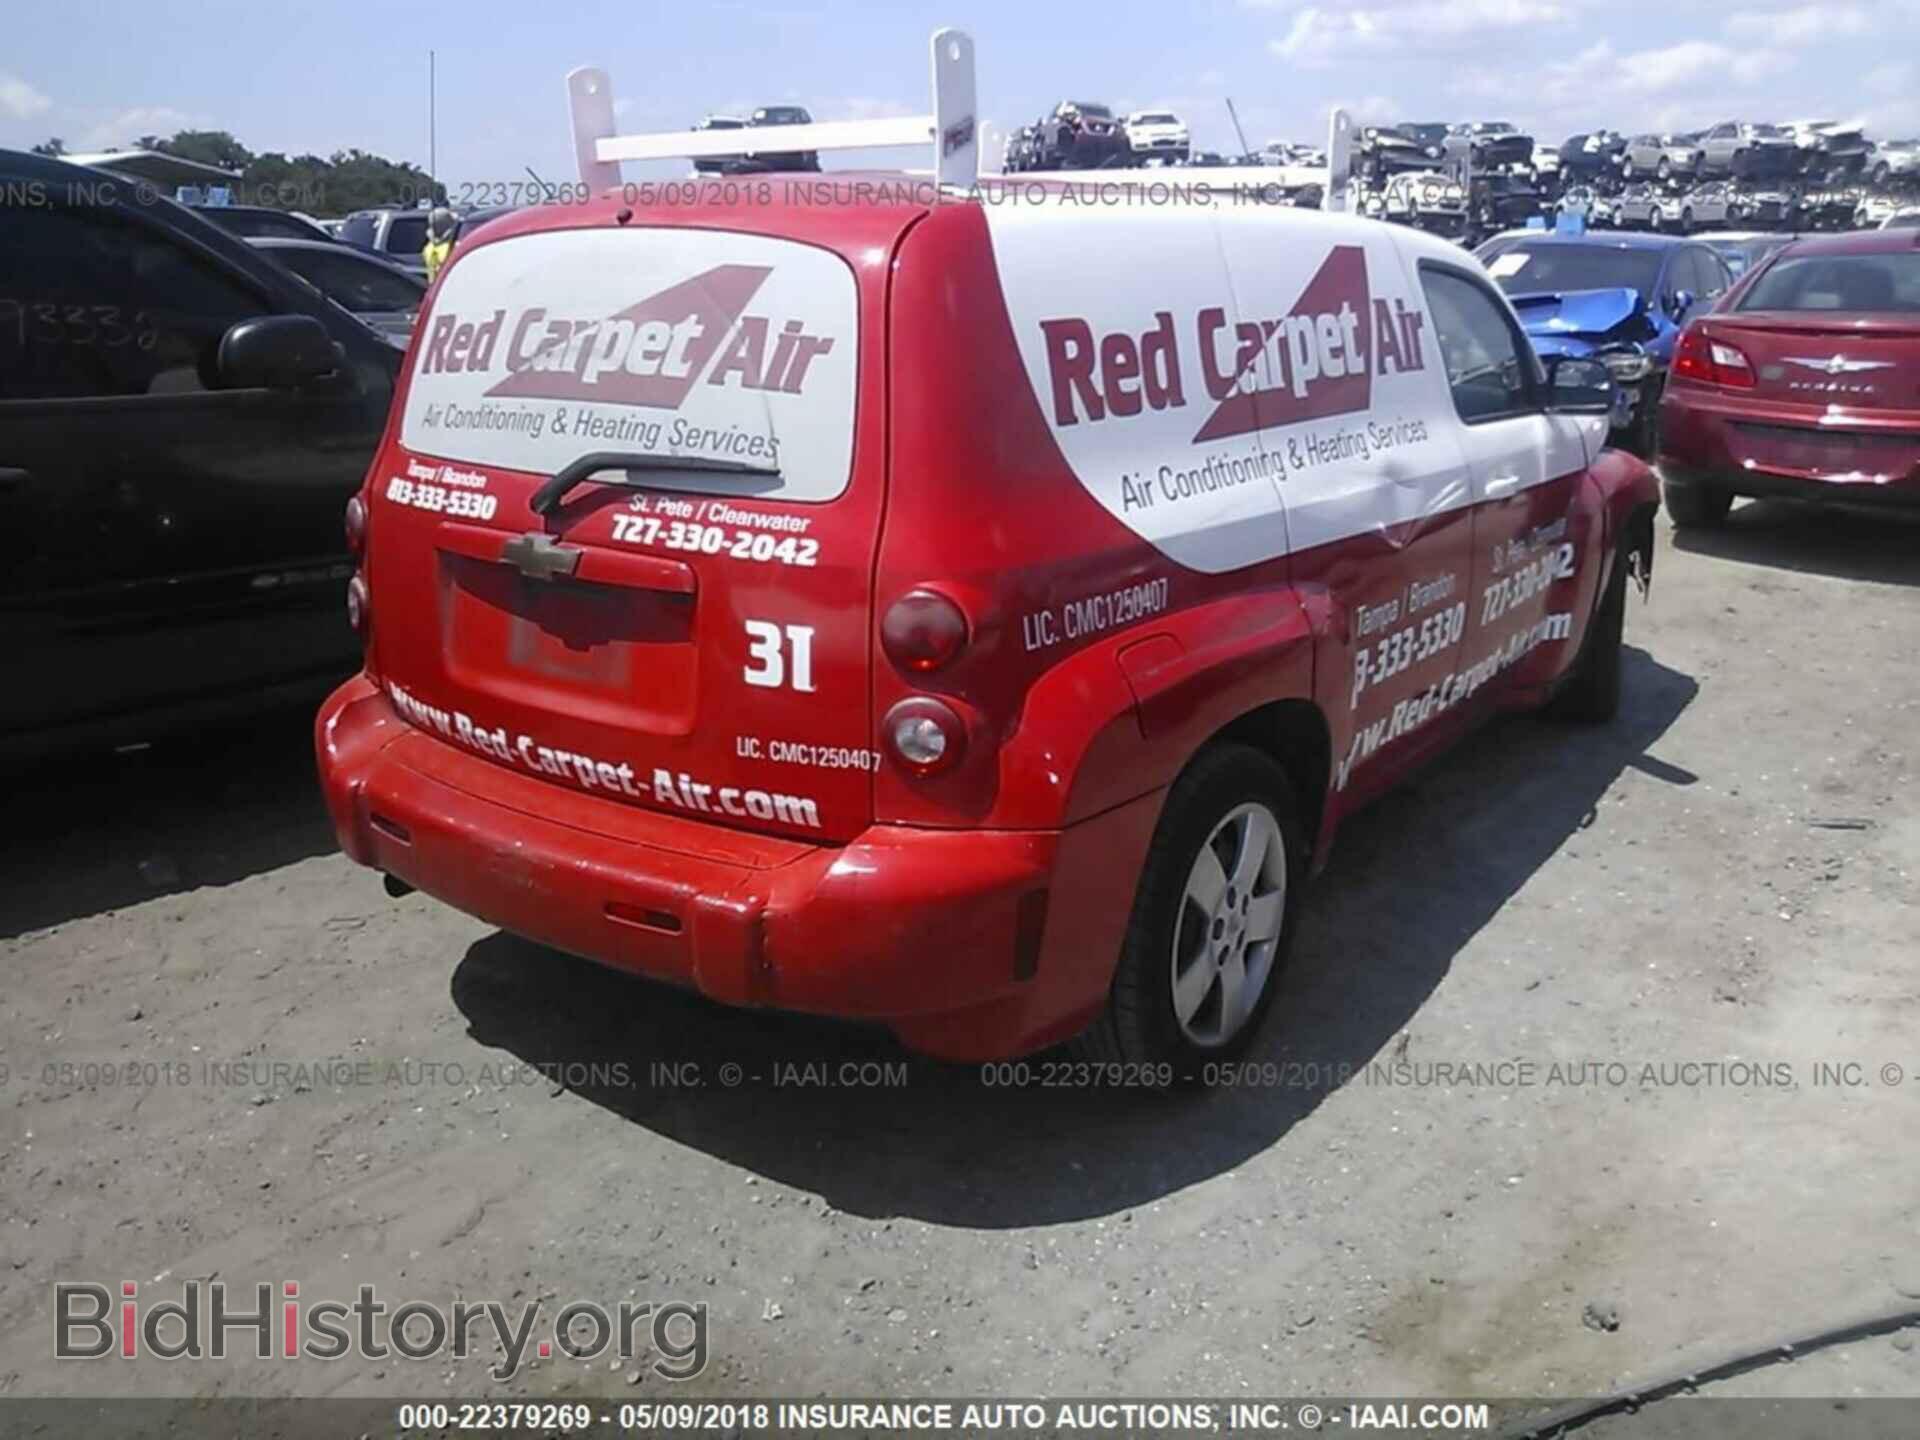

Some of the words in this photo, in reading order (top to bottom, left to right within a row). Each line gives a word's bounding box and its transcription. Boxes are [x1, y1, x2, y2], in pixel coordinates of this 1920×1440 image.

[422, 309, 505, 374] Red
[506, 308, 706, 383] Carpet
[706, 315, 835, 395] Air
[1040, 311, 1187, 427] Red
[1197, 300, 1366, 401] Carpet
[1373, 298, 1424, 375] Air
[421, 403, 442, 429] Air
[443, 404, 544, 440] Conditioning
[551, 410, 568, 434] &
[574, 415, 659, 449] Heating
[669, 419, 782, 460] Services
[1123, 474, 1155, 513] Air
[1158, 450, 1286, 502] Conditioning
[1287, 438, 1304, 470] &
[1307, 428, 1367, 466] Heating
[1368, 417, 1429, 453] Services
[387, 477, 498, 520] 813-333-5330
[655, 498, 694, 518] Pete
[707, 503, 812, 533] Clearwater
[611, 513, 820, 567] 727-330-2042
[1023, 610, 1061, 651] LIC.
[1063, 577, 1169, 639] CMC1250407
[743, 619, 817, 693] 31
[736, 736, 766, 759] LIC.
[768, 740, 881, 773] CMC1250407
